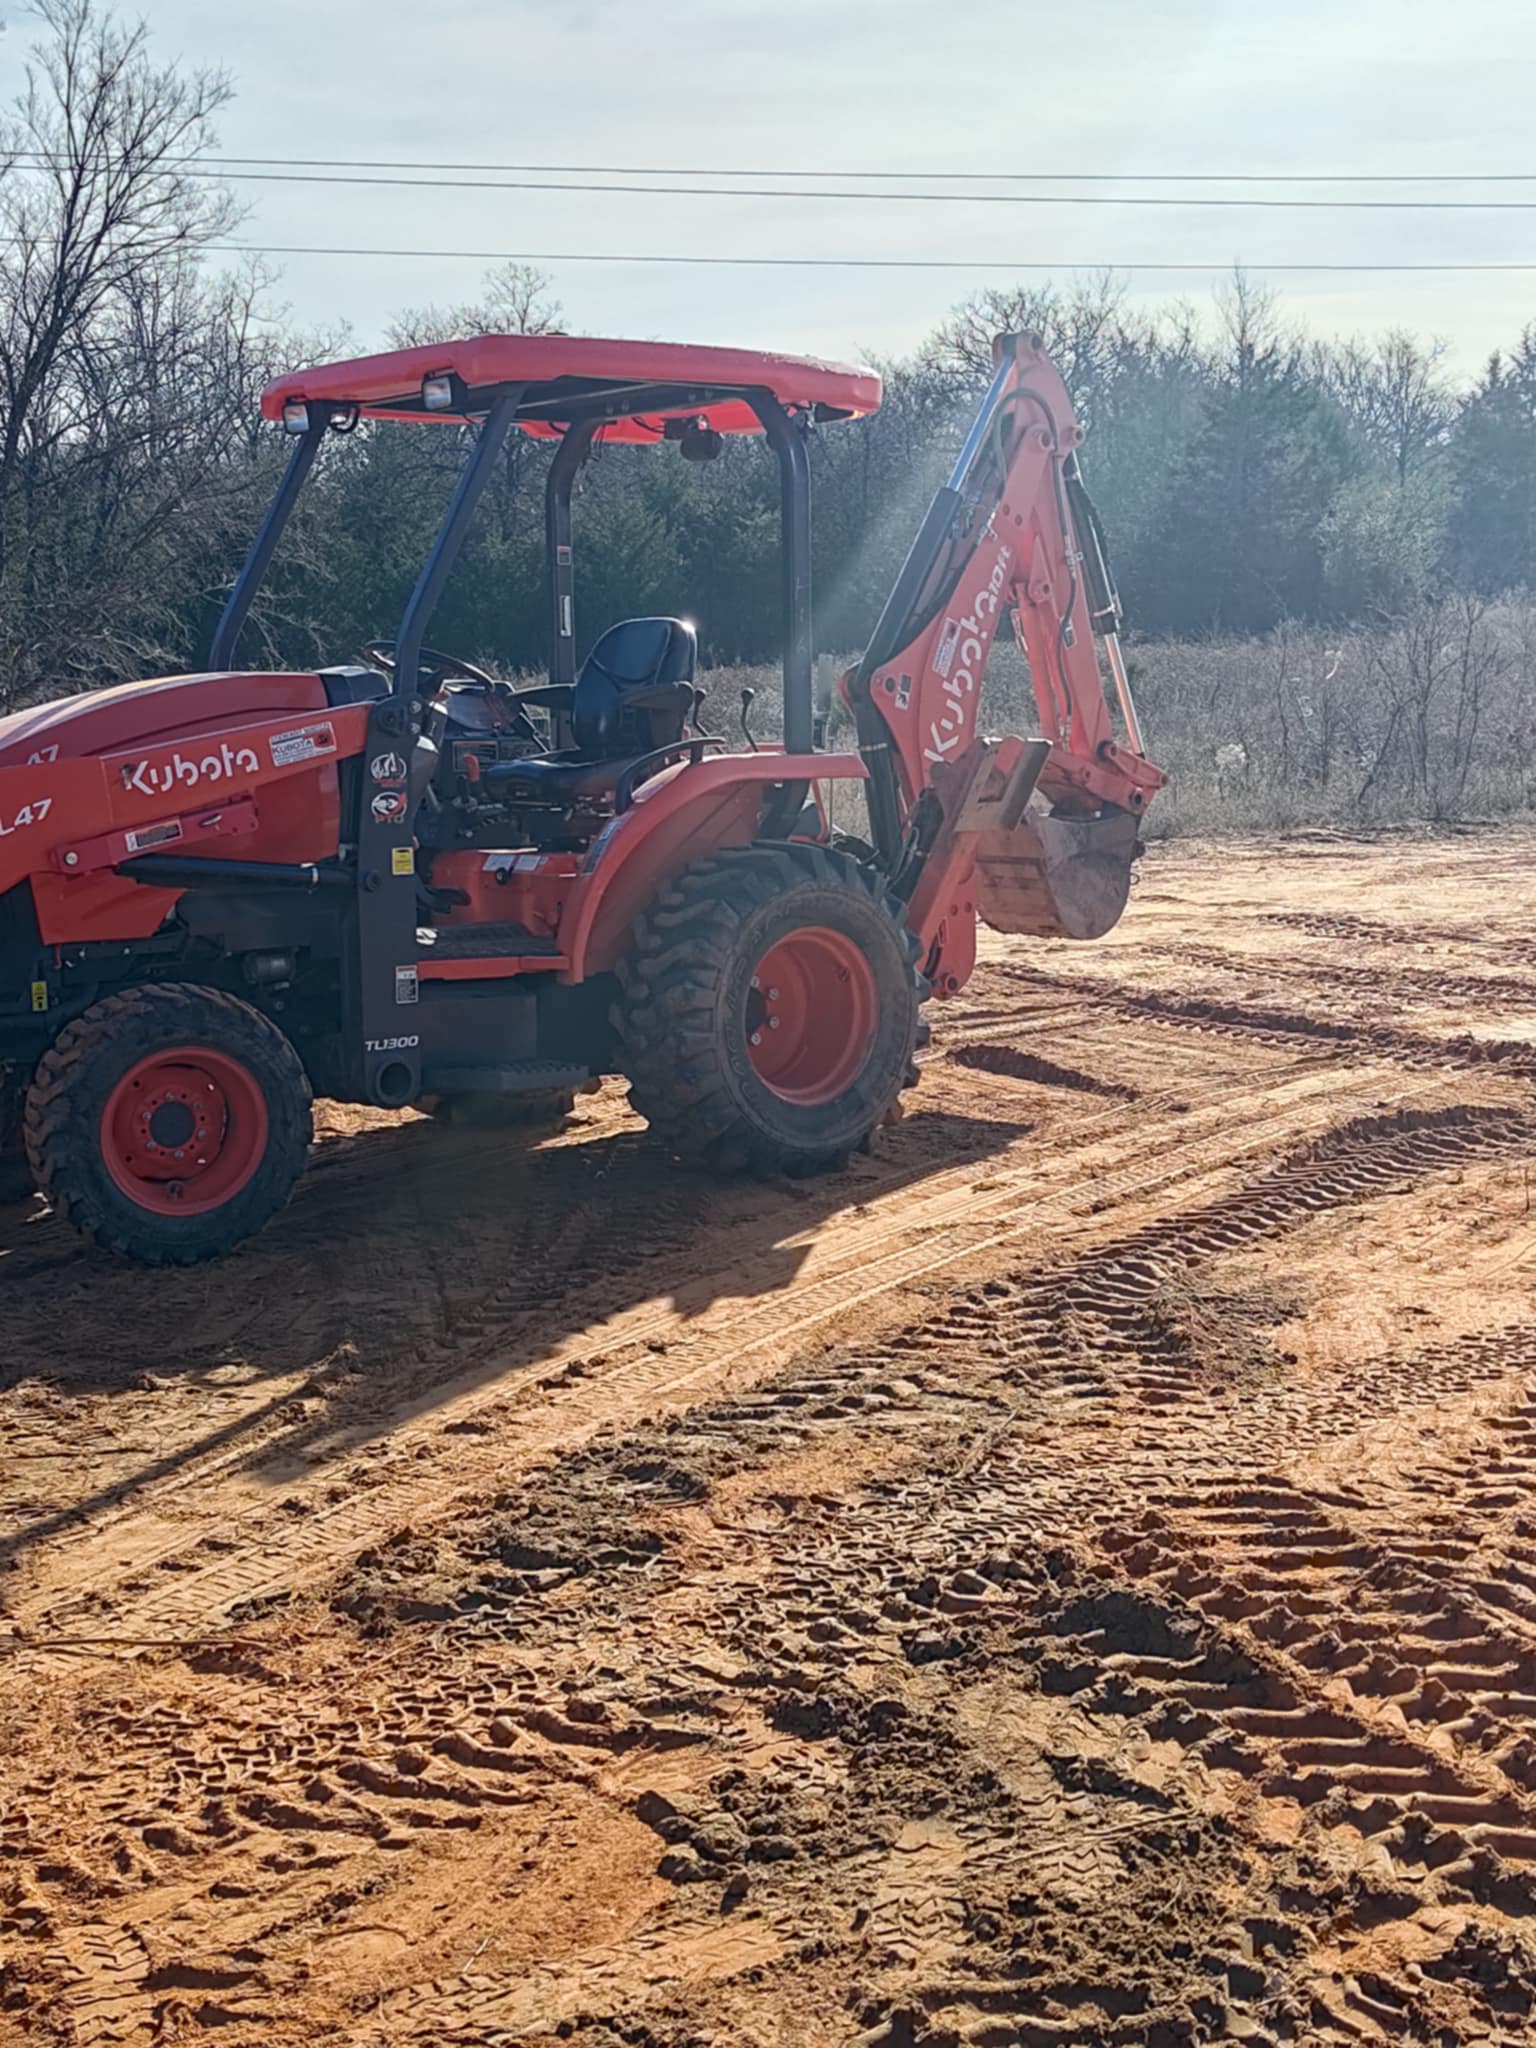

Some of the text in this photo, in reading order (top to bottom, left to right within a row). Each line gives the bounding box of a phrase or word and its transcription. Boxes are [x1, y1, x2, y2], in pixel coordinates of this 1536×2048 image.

[923, 591, 998, 763] Kubota
[121, 743, 260, 795] Kubota
[364, 1034, 420, 1053] TL1300
